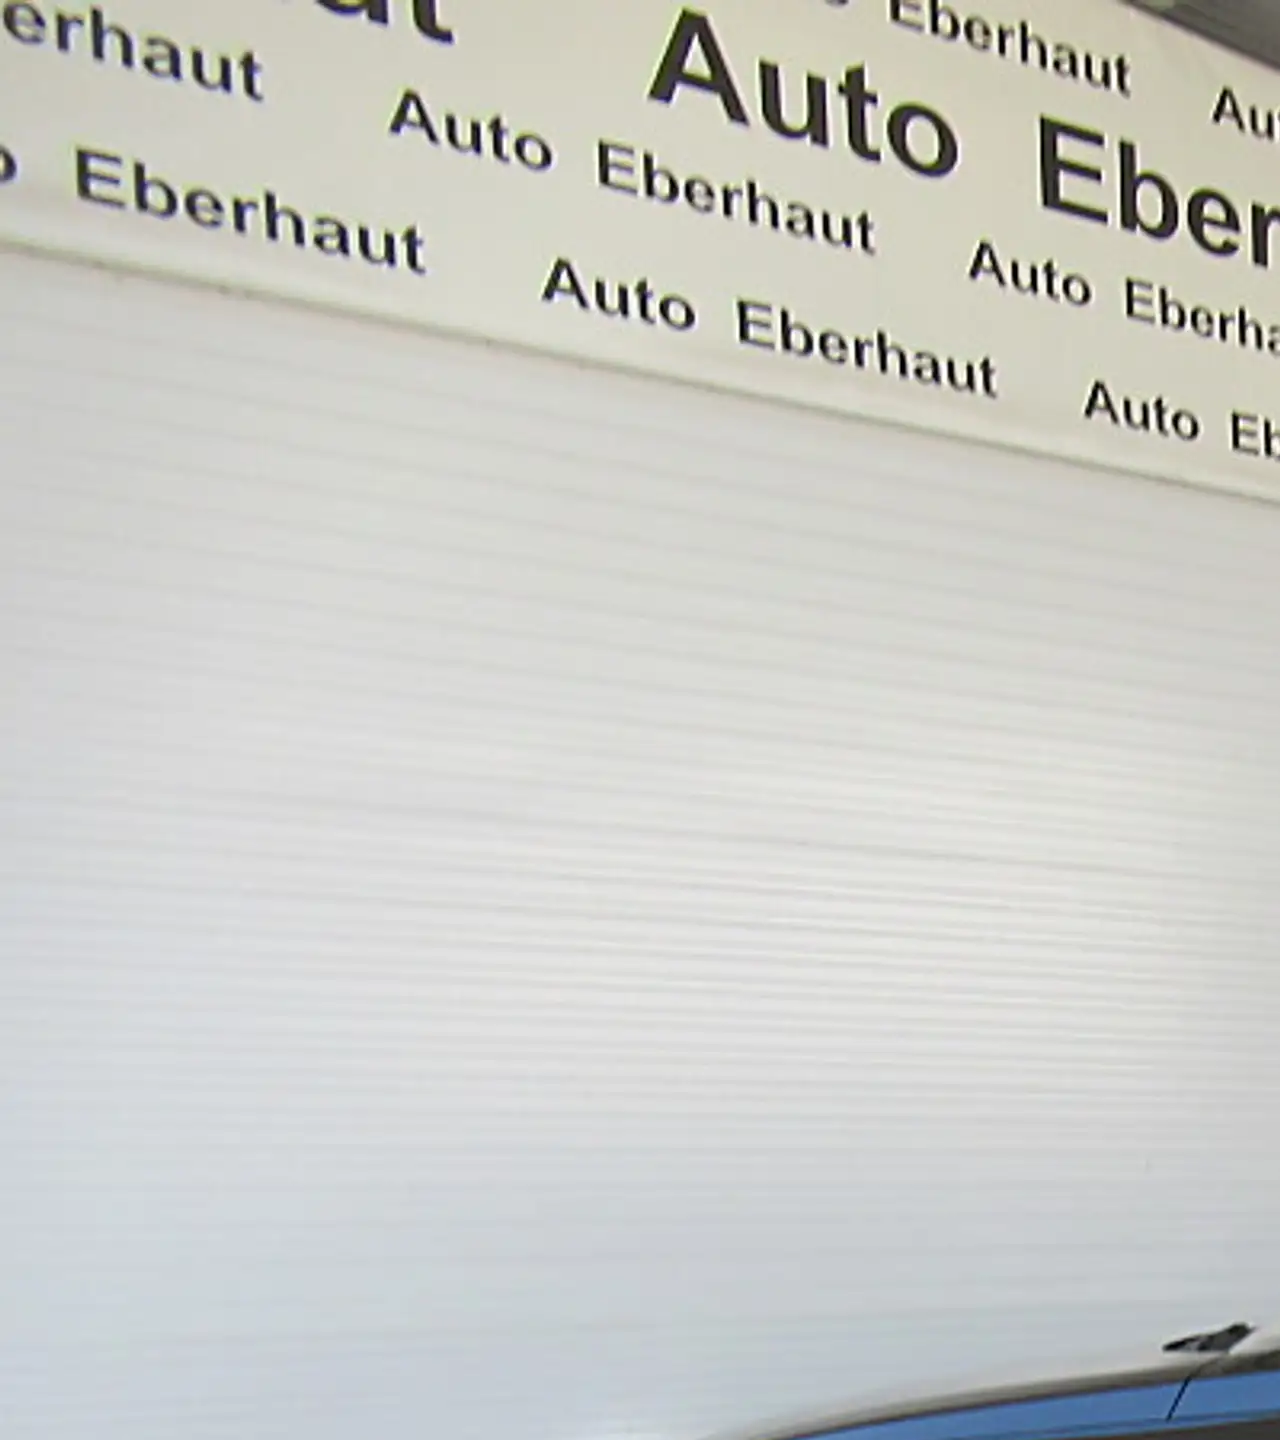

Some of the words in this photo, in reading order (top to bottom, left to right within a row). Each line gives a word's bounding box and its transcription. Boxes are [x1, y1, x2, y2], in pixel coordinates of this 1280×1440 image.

[647, 7, 959, 179] Auto
[889, 0, 1131, 97] Eberhaut
[76, 149, 425, 274] Eberhaut
[390, 90, 552, 170] Auto
[598, 138, 878, 253] Eberhaut
[542, 258, 695, 330] Auto
[737, 300, 994, 397] Eberhaut
[969, 241, 1091, 305] Auto
[1084, 381, 1199, 440] Auto
